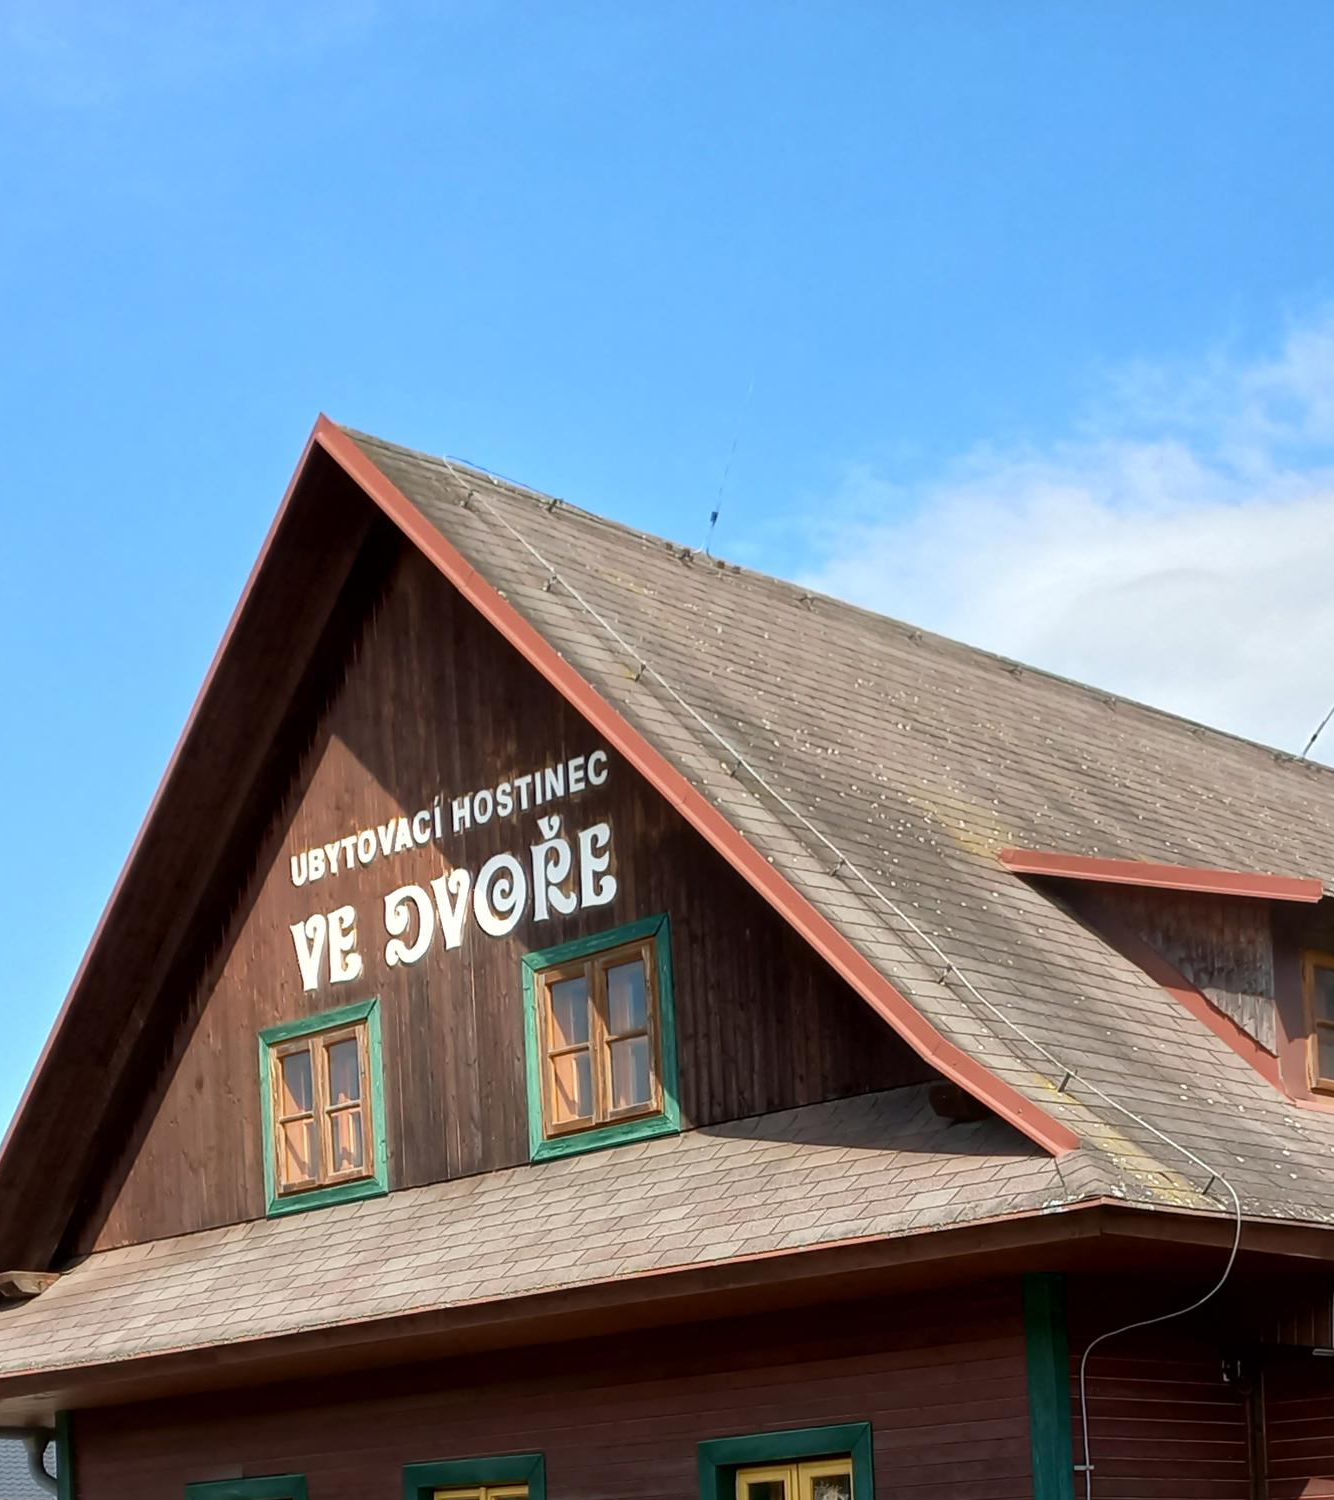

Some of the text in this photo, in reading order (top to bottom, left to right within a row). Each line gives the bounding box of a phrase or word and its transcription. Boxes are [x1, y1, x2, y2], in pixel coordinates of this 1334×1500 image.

[290, 749, 609, 887] UBYTOVACÍ HOSTINEC
[290, 815, 618, 992] VE DVOŘE
